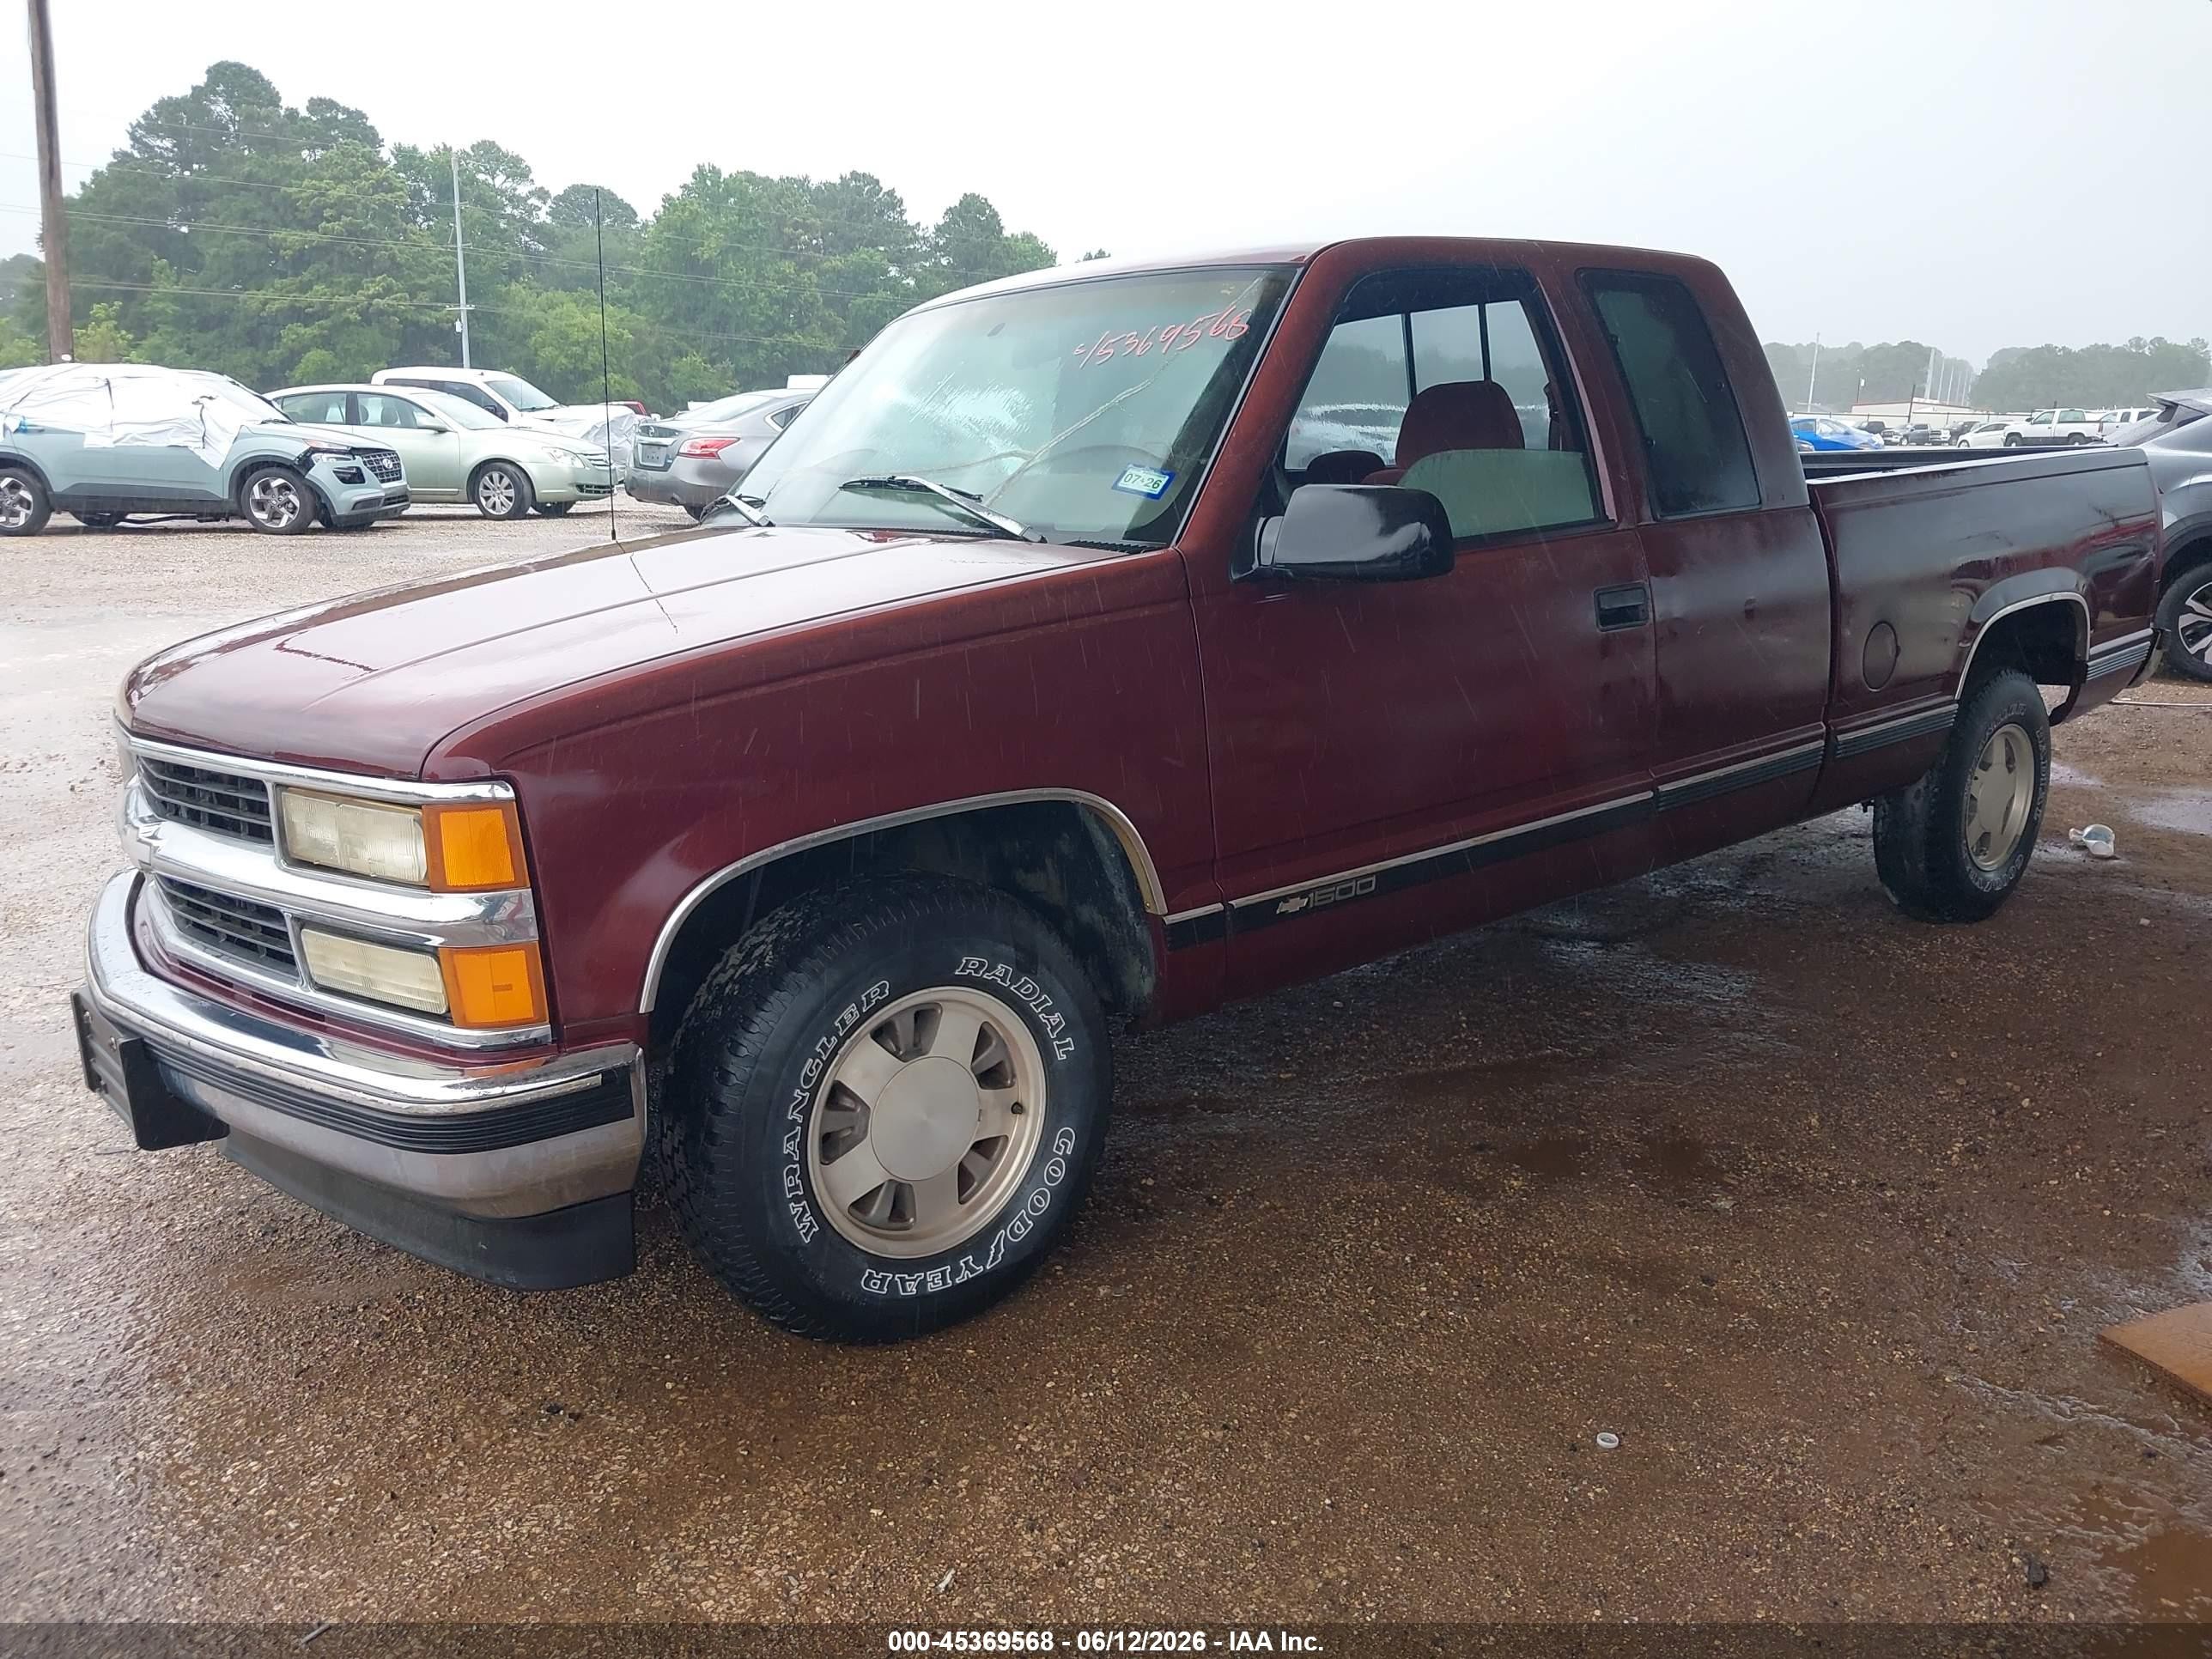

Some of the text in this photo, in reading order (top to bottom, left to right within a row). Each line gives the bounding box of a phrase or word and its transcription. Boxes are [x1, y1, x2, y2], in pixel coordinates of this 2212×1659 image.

[1073, 305, 1253, 369] 45369568
[1308, 875, 1376, 908] 1500
[783, 957, 1078, 1243] WRANGLER RADIAL
